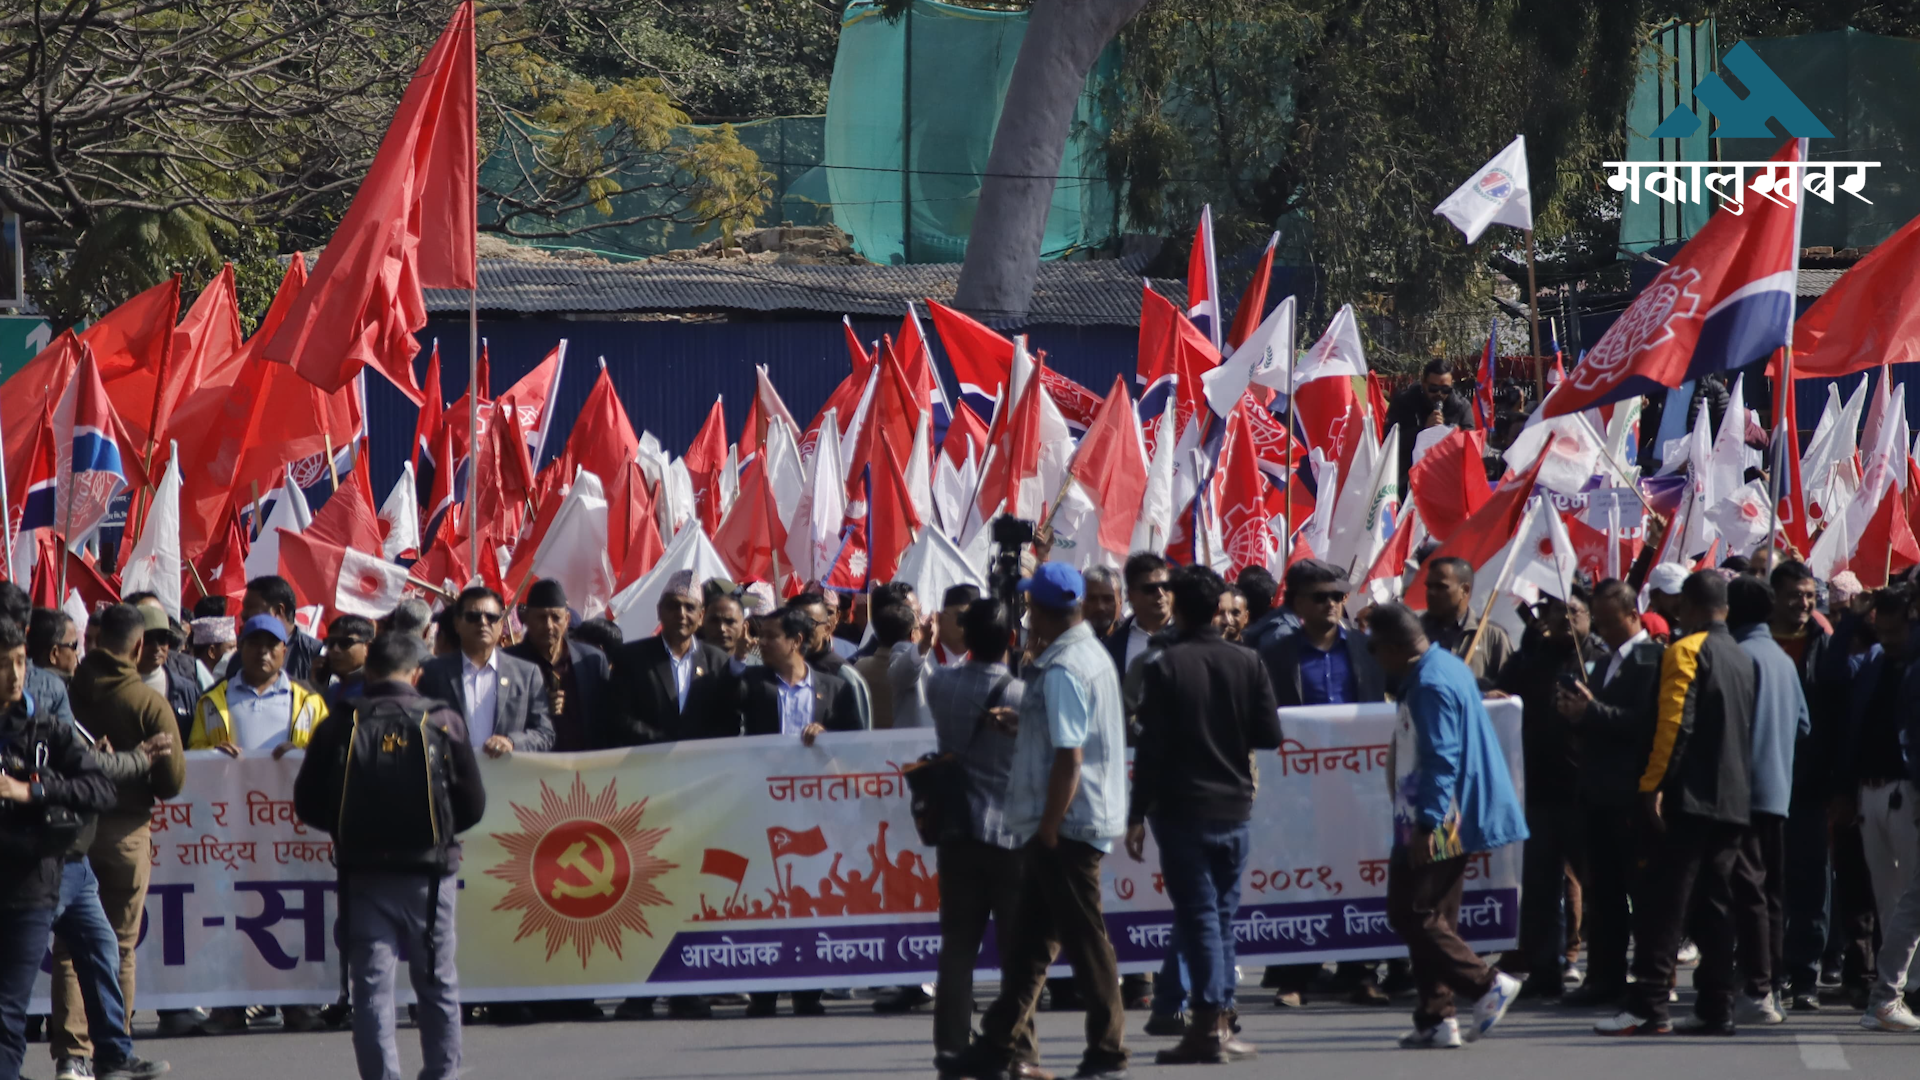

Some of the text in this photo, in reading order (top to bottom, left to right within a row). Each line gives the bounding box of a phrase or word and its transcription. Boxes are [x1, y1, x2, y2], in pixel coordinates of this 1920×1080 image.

[1277, 739, 1390, 777] जिन्दा
[150, 790, 306, 835] द्वेष र विकृ
[272, 842, 334, 865] एकत
[1114, 877, 1134, 900] ७
[681, 936, 782, 968] आयोजक
[816, 932, 885, 963] नेकपा
